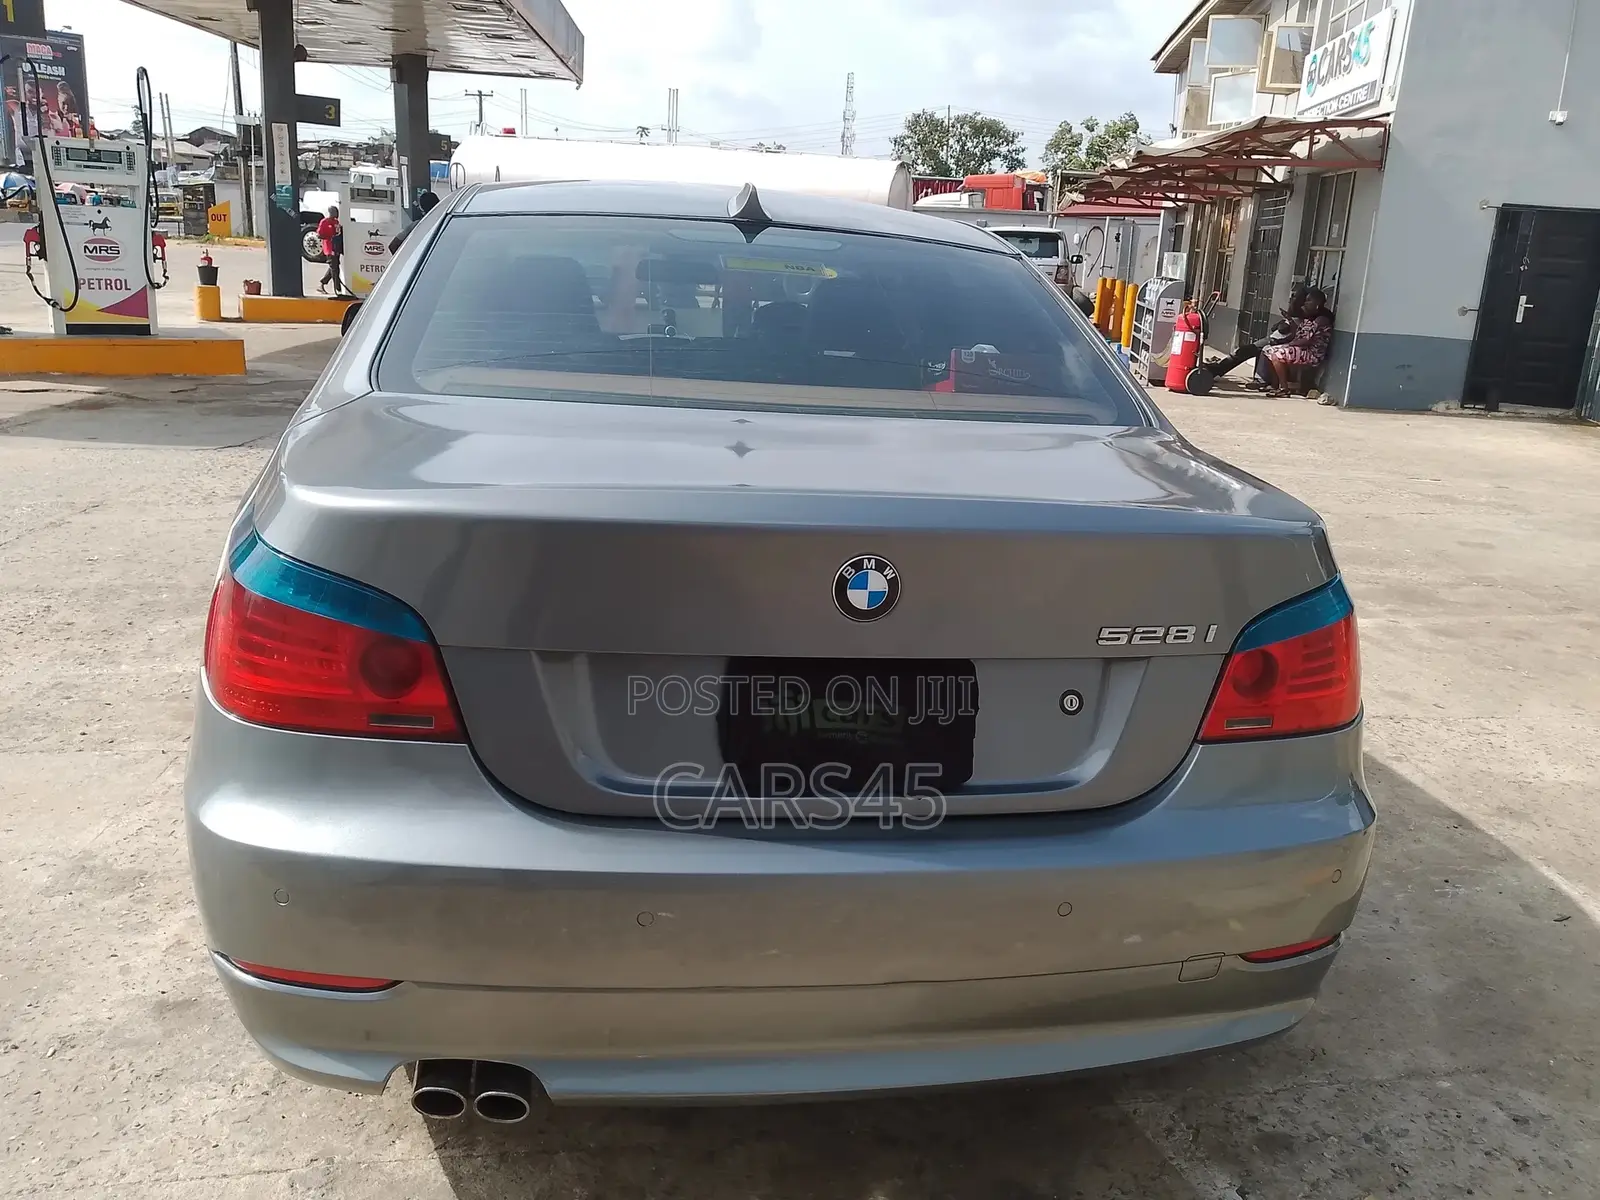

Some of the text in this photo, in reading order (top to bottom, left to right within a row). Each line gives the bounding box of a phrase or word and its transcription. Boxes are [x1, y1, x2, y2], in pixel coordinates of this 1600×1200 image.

[22, 62, 66, 76] ULEASH
[324, 104, 336, 120] 3
[440, 140, 448, 151] 5
[211, 213, 227, 222] OUT
[83, 245, 121, 255] MRS
[360, 264, 387, 273] PETRO
[79, 278, 131, 291] PETROL
[842, 558, 896, 580] BMW
[1097, 625, 1197, 646] 528
